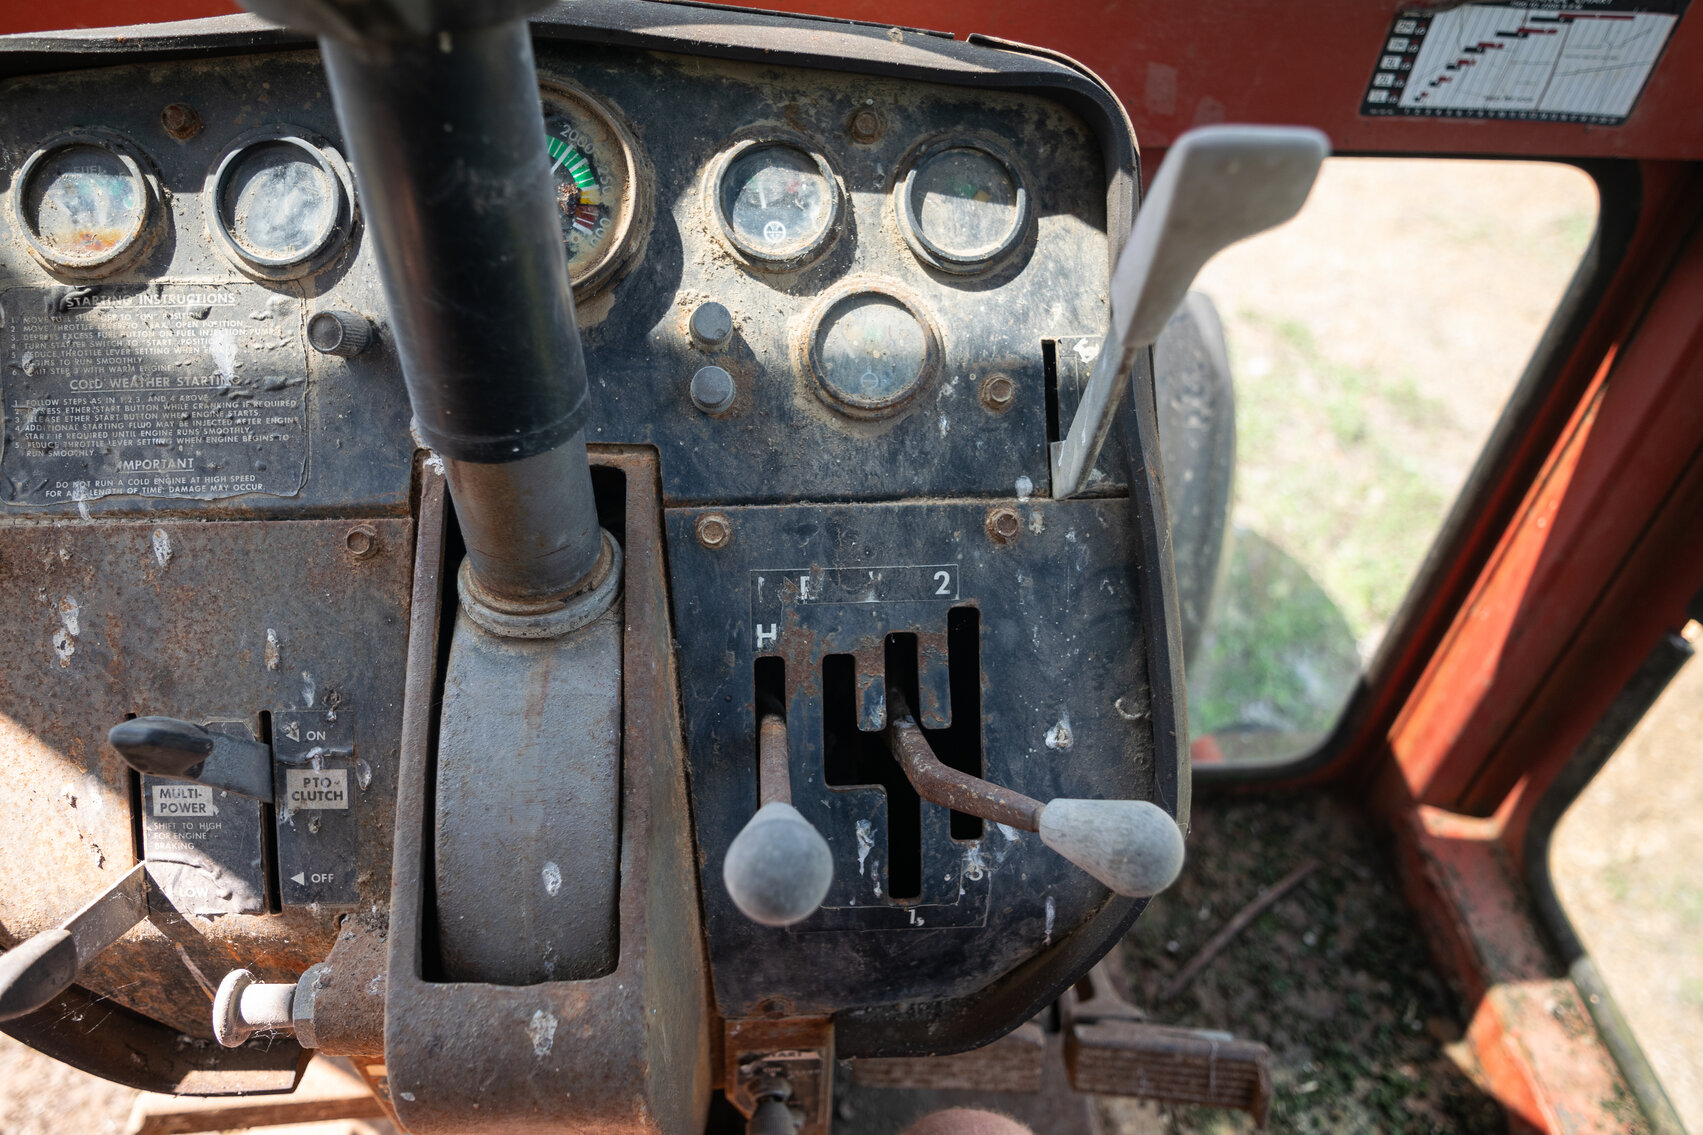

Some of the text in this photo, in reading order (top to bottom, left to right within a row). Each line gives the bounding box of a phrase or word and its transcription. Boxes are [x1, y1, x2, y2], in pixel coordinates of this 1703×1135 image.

[560, 125, 595, 154] 2000
[139, 293, 236, 305] INSTRUCTIONS
[176, 320, 199, 328] OPEN
[63, 331, 93, 339] EXCESS
[176, 329, 196, 337] FUEL
[24, 342, 47, 350] TURN
[127, 338, 138, 346] TO
[24, 350, 57, 359] EDUCE
[106, 348, 131, 356] LEVER
[135, 346, 170, 355] SETTING
[174, 346, 200, 354] WHEN
[60, 358, 71, 366] TO
[75, 357, 93, 366] RUN
[84, 365, 105, 374] WITH
[109, 364, 136, 373] WARM
[70, 374, 241, 390] COLD WEATHER STARTING
[26, 398, 60, 408] FOLLOW
[63, 397, 88, 406] STEPS
[90, 396, 103, 405] AS
[106, 396, 116, 404] IN
[148, 394, 167, 402] AND
[65, 405, 91, 414] ETHER
[95, 404, 121, 413] START
[125, 403, 159, 412] BUTTON
[163, 401, 189, 410] WHILE
[193, 400, 240, 410] CRANKING
[27, 415, 61, 424] ELEASE
[64, 414, 91, 423] ETHER
[95, 413, 120, 422] START
[124, 411, 158, 420] BUTTON
[162, 410, 188, 419] WHEN
[192, 410, 225, 418] ENGINE
[25, 423, 79, 432] ADDITIONAL
[83, 421, 124, 431] STARTING
[156, 420, 176, 428] MAY
[179, 419, 190, 427] BE
[193, 417, 233, 427] INJECTED
[236, 416, 263, 426] AFTER
[266, 415, 300, 425] ENGINE
[25, 432, 51, 441] START
[55, 431, 64, 440] IF
[66, 430, 109, 440] REQUIRED
[112, 430, 137, 439] UNTIL
[141, 428, 173, 437] ENGINE
[177, 427, 200, 436] RUNS
[108, 437, 134, 447] LEVER
[137, 437, 172, 446] SETTING
[177, 436, 203, 445] WHEN
[206, 434, 240, 443] ENGINE
[242, 433, 275, 443] BEGINS
[26, 449, 46, 458] RUN
[118, 457, 195, 470] IMPORTANT
[55, 480, 69, 489] DO
[95, 478, 115, 487] RUN
[117, 478, 125, 487] A
[128, 477, 151, 486] COLD
[154, 476, 188, 485] ENGINE
[190, 475, 202, 484] AT
[204, 474, 227, 484] HIGH
[230, 473, 256, 483] SPEED
[45, 488, 63, 497] FOR
[127, 486, 139, 495] OF
[168, 484, 208, 494] DAMAGE
[210, 483, 231, 493] MAY
[234, 482, 267, 492] OCCUR.
[934, 570, 951, 595] 2
[756, 623, 777, 648] H
[306, 730, 326, 741] ON
[303, 777, 332, 788] PTO
[159, 788, 203, 799] MULTI-
[291, 790, 344, 802] CLUTCH
[159, 802, 207, 814] POWER
[153, 822, 222, 831] SHIFT TO HIGH
[154, 832, 207, 840] FOR ENGINE
[154, 842, 195, 850] BRAKING
[311, 873, 335, 884] OFF
[180, 887, 208, 898] LOW
